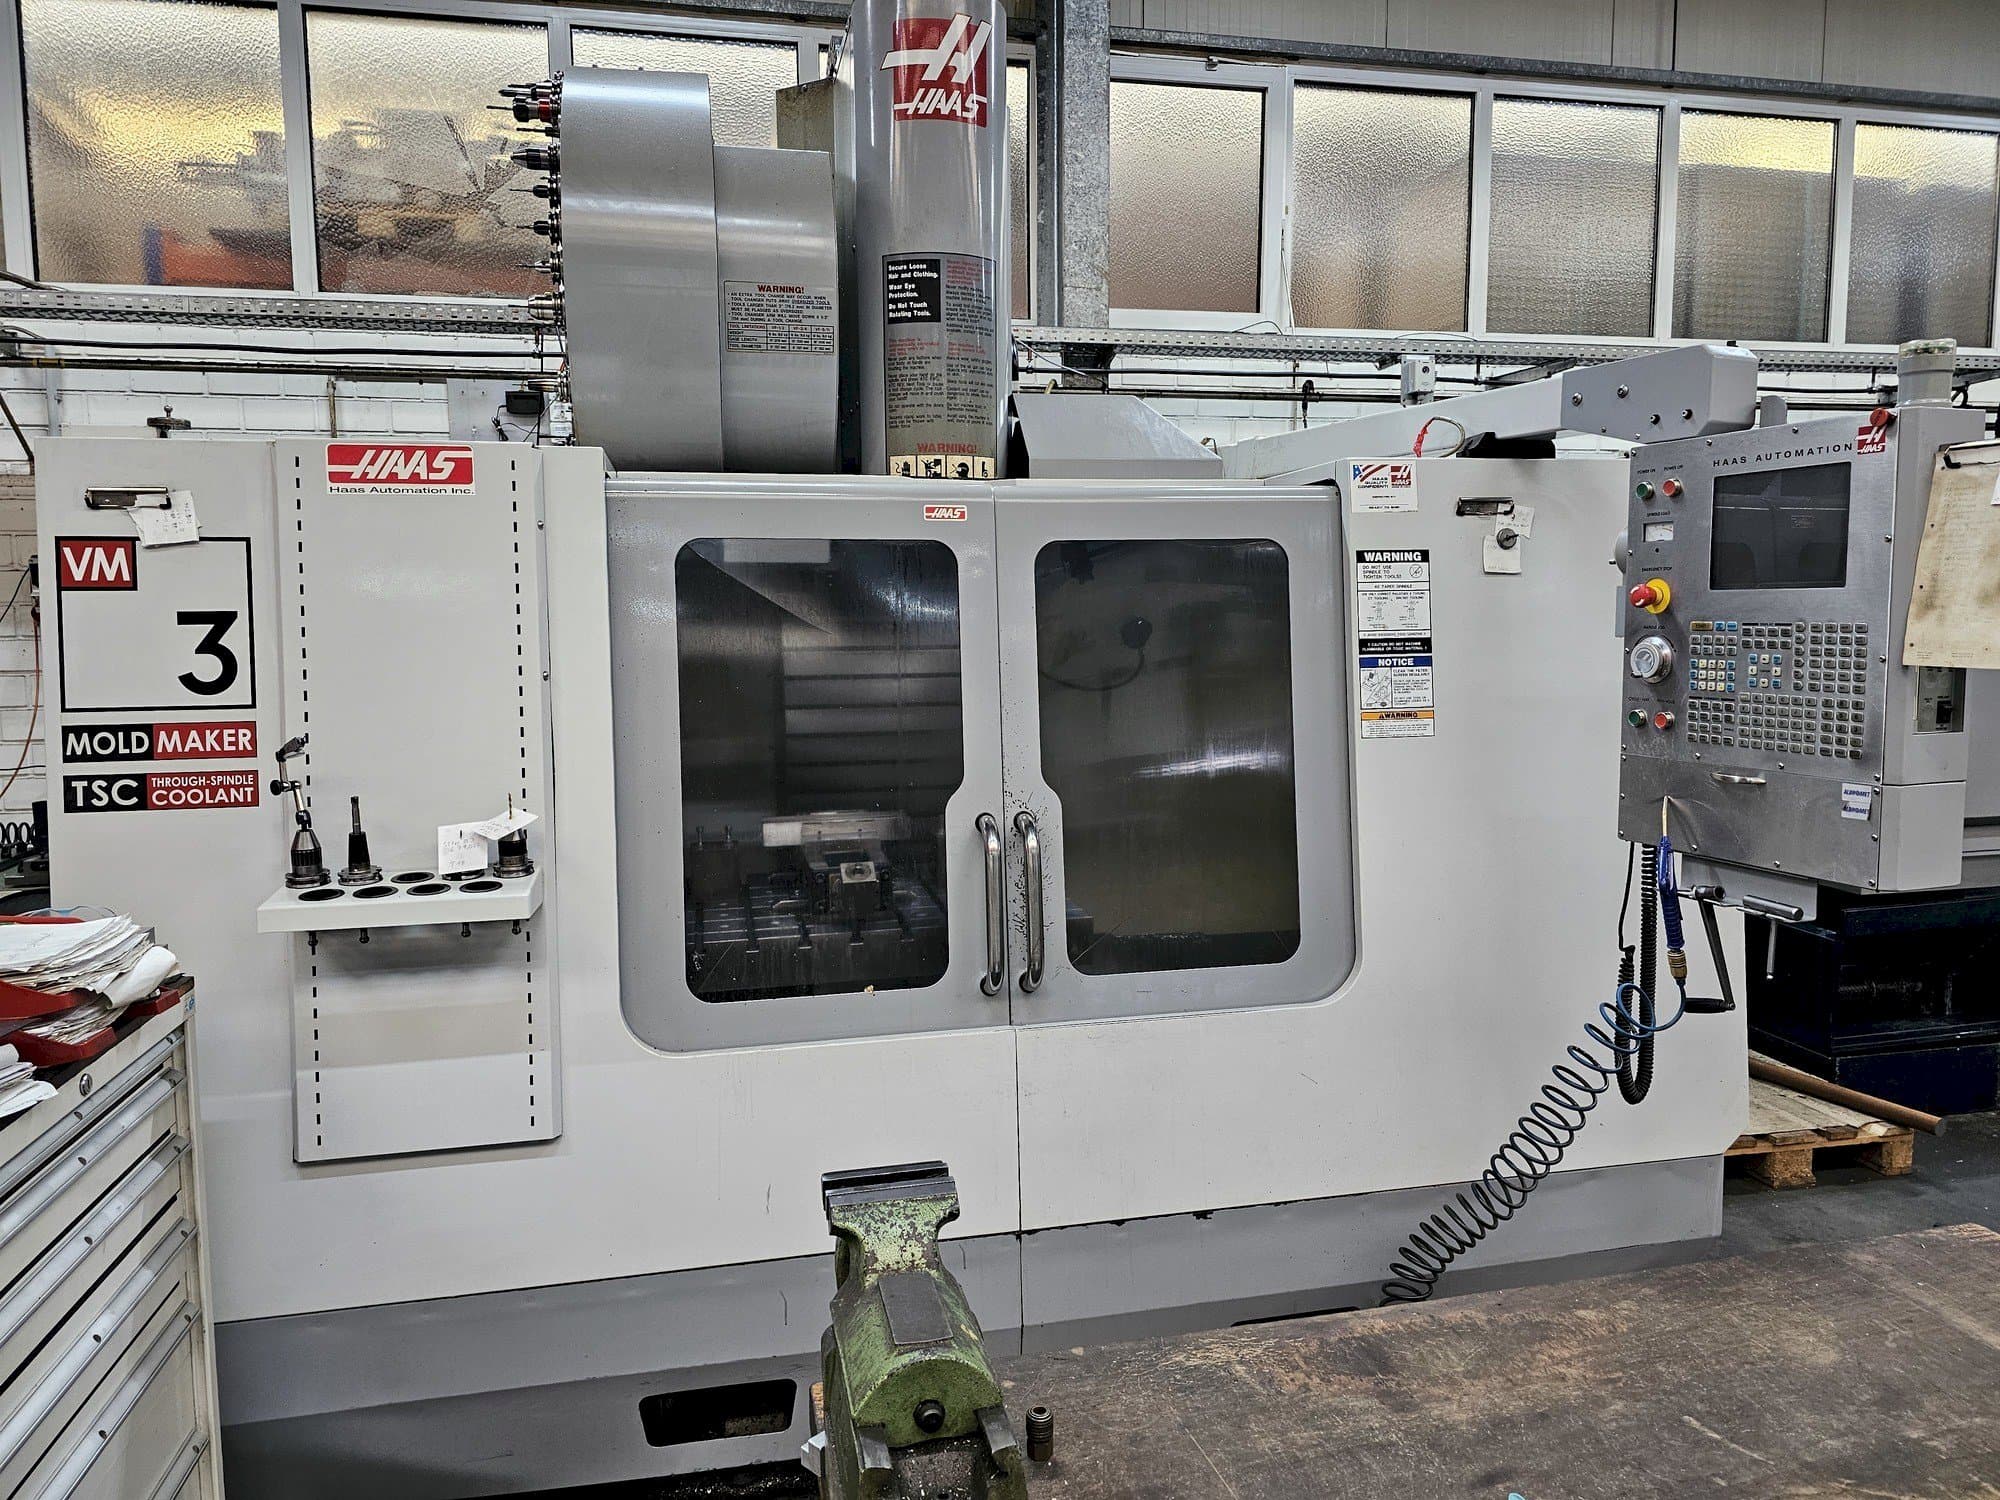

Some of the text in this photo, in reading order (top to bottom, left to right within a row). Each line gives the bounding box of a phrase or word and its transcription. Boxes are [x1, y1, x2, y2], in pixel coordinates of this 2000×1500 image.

[894, 88, 987, 118] HAAS
[757, 284, 804, 294] WARNING!
[904, 282, 916, 290] Eye
[916, 443, 978, 454] WARNING!
[1713, 443, 1853, 467] HAAS AUTOMATION
[327, 449, 473, 480] HAAS
[370, 486, 446, 494] Automation
[451, 486, 475, 494] Inc.
[925, 508, 967, 518] HAAS
[62, 545, 131, 582] VM
[1364, 552, 1422, 562] WARNING
[176, 610, 239, 696] 3
[1378, 658, 1414, 666] NOTICE
[66, 728, 253, 756] MOLD MAKER
[151, 773, 254, 787] THROUGH-SPINDLE
[71, 779, 140, 806] TSC
[151, 787, 254, 806] COOLANT
